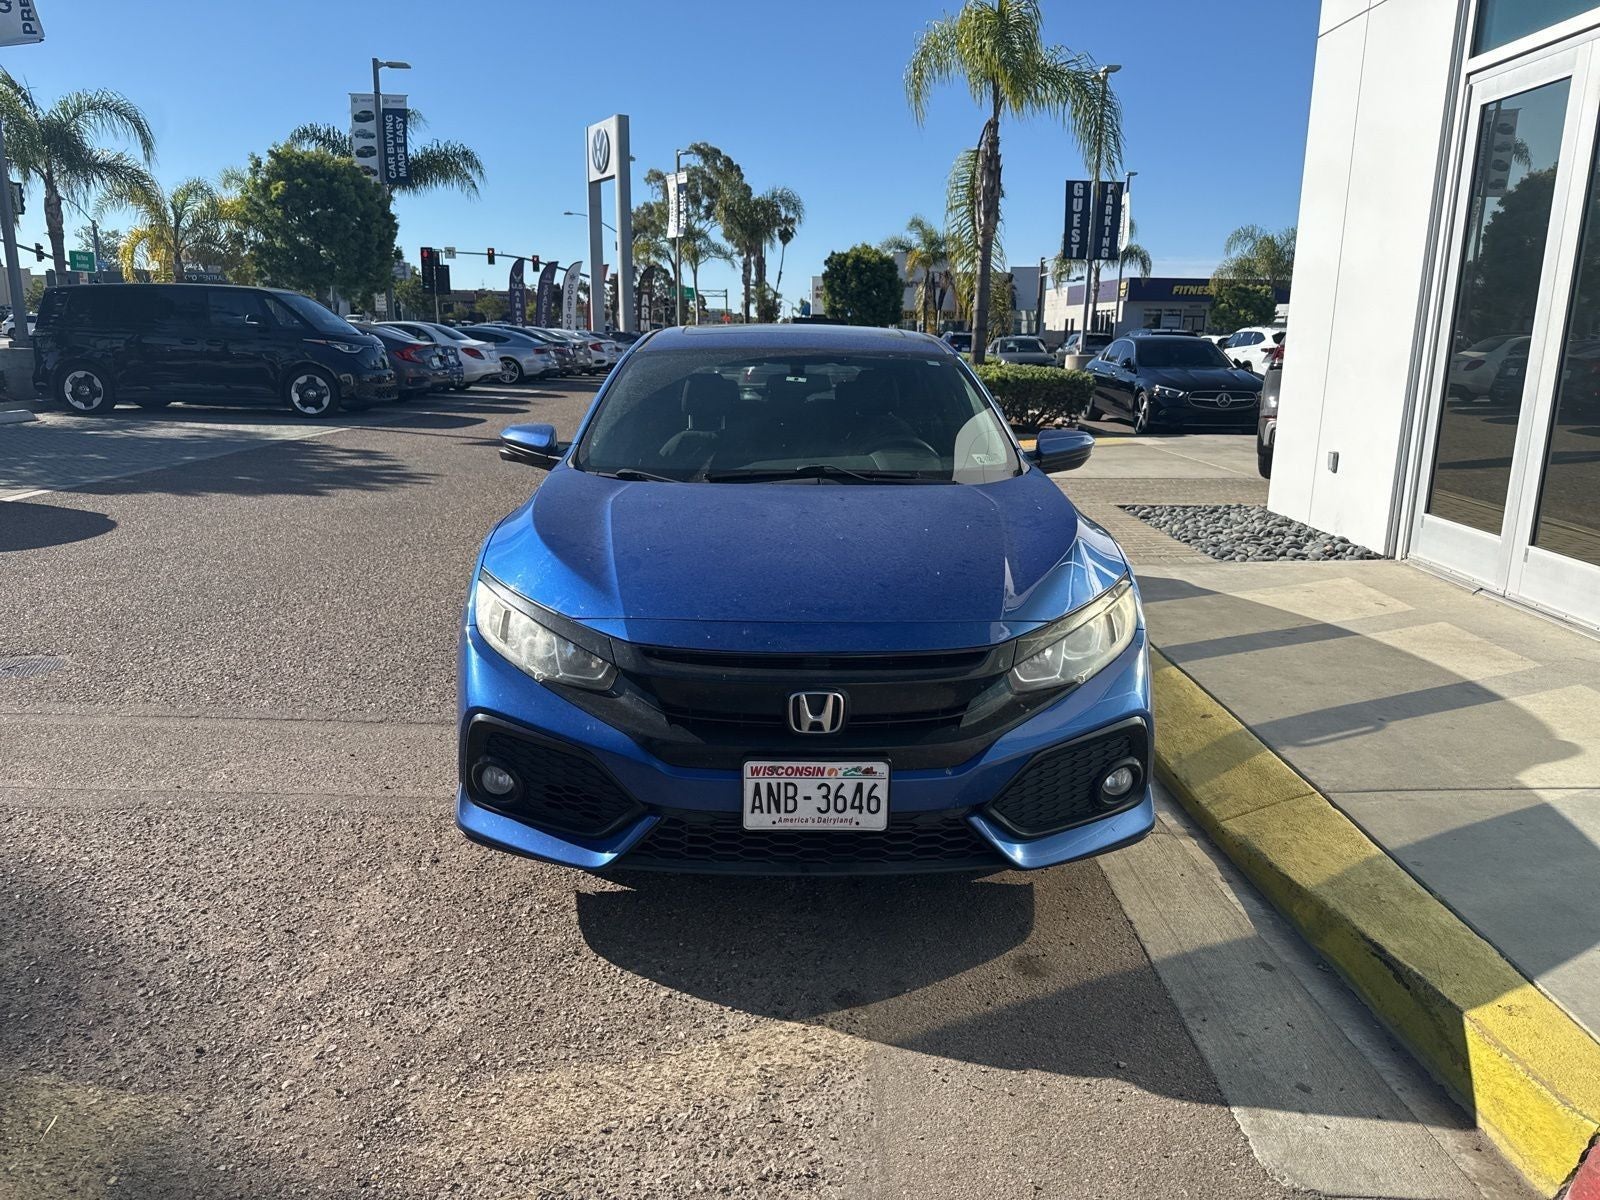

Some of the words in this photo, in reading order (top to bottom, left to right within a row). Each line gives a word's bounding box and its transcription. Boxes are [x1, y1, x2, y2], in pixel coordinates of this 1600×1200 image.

[385, 114, 395, 154] BUYING
[395, 116, 404, 144] EASY
[387, 157, 397, 179] CAR
[396, 145, 408, 177] MADE
[1070, 182, 1084, 258] GUEST
[1100, 183, 1115, 258] PARKING
[566, 284, 574, 312] COAST
[750, 766, 826, 777] WISCONSIN
[750, 782, 881, 814] ANB-3646
[777, 816, 815, 824] America's
[816, 816, 854, 826] Dairyland
